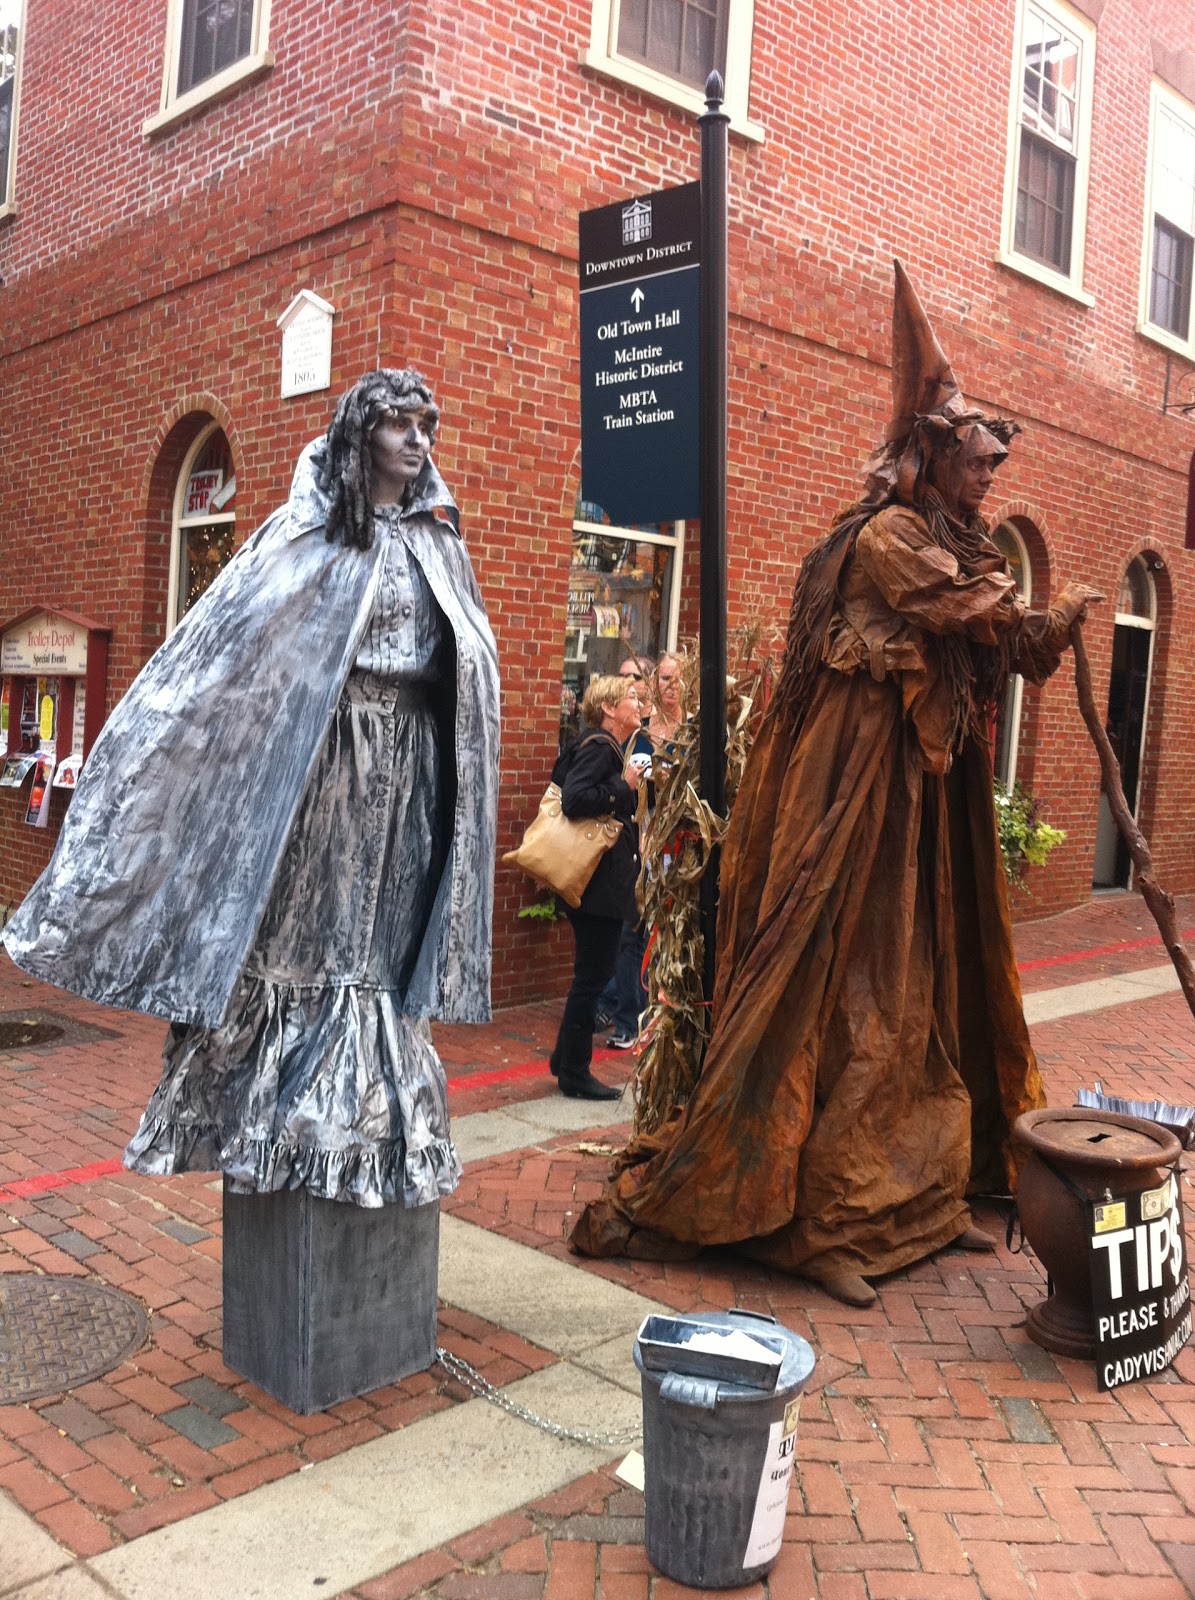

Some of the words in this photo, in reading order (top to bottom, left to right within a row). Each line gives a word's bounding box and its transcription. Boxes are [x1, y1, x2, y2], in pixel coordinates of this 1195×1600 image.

[597, 321, 618, 341] Old
[620, 318, 652, 337] Town
[655, 309, 681, 330] Hall
[614, 345, 663, 365] McIntire
[595, 367, 639, 387] Historic
[641, 360, 684, 380] District
[619, 390, 658, 410] MBTA
[603, 414, 633, 431] Train
[635, 408, 675, 426] Station
[188, 491, 209, 513] STOP
[28, 630, 50, 652] Trolley
[51, 630, 75, 652] Depot
[33, 653, 50, 666] Special
[51, 653, 67, 663] Events
[1099, 1303, 1158, 1342] PLEASE
